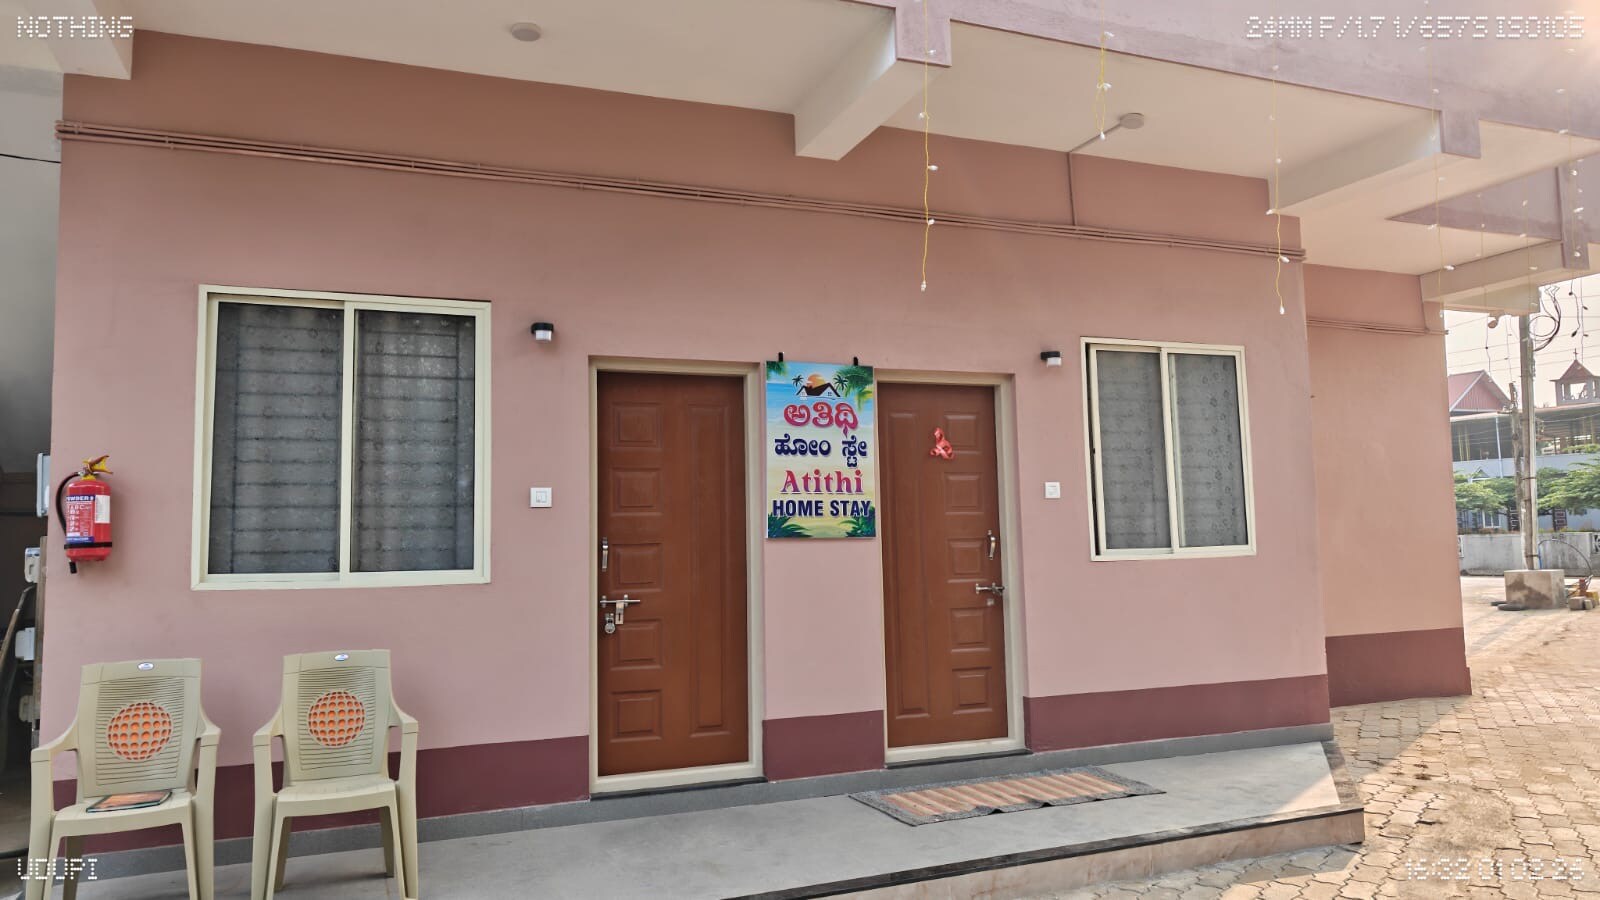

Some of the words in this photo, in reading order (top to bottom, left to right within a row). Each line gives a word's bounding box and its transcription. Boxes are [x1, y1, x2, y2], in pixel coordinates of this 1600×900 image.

[783, 401, 859, 437] ಅತಿಥಿ
[774, 433, 831, 457] ಹೋಂ
[781, 469, 864, 494] Atithi
[772, 500, 824, 517] HOME
[830, 500, 872, 517] STAY
